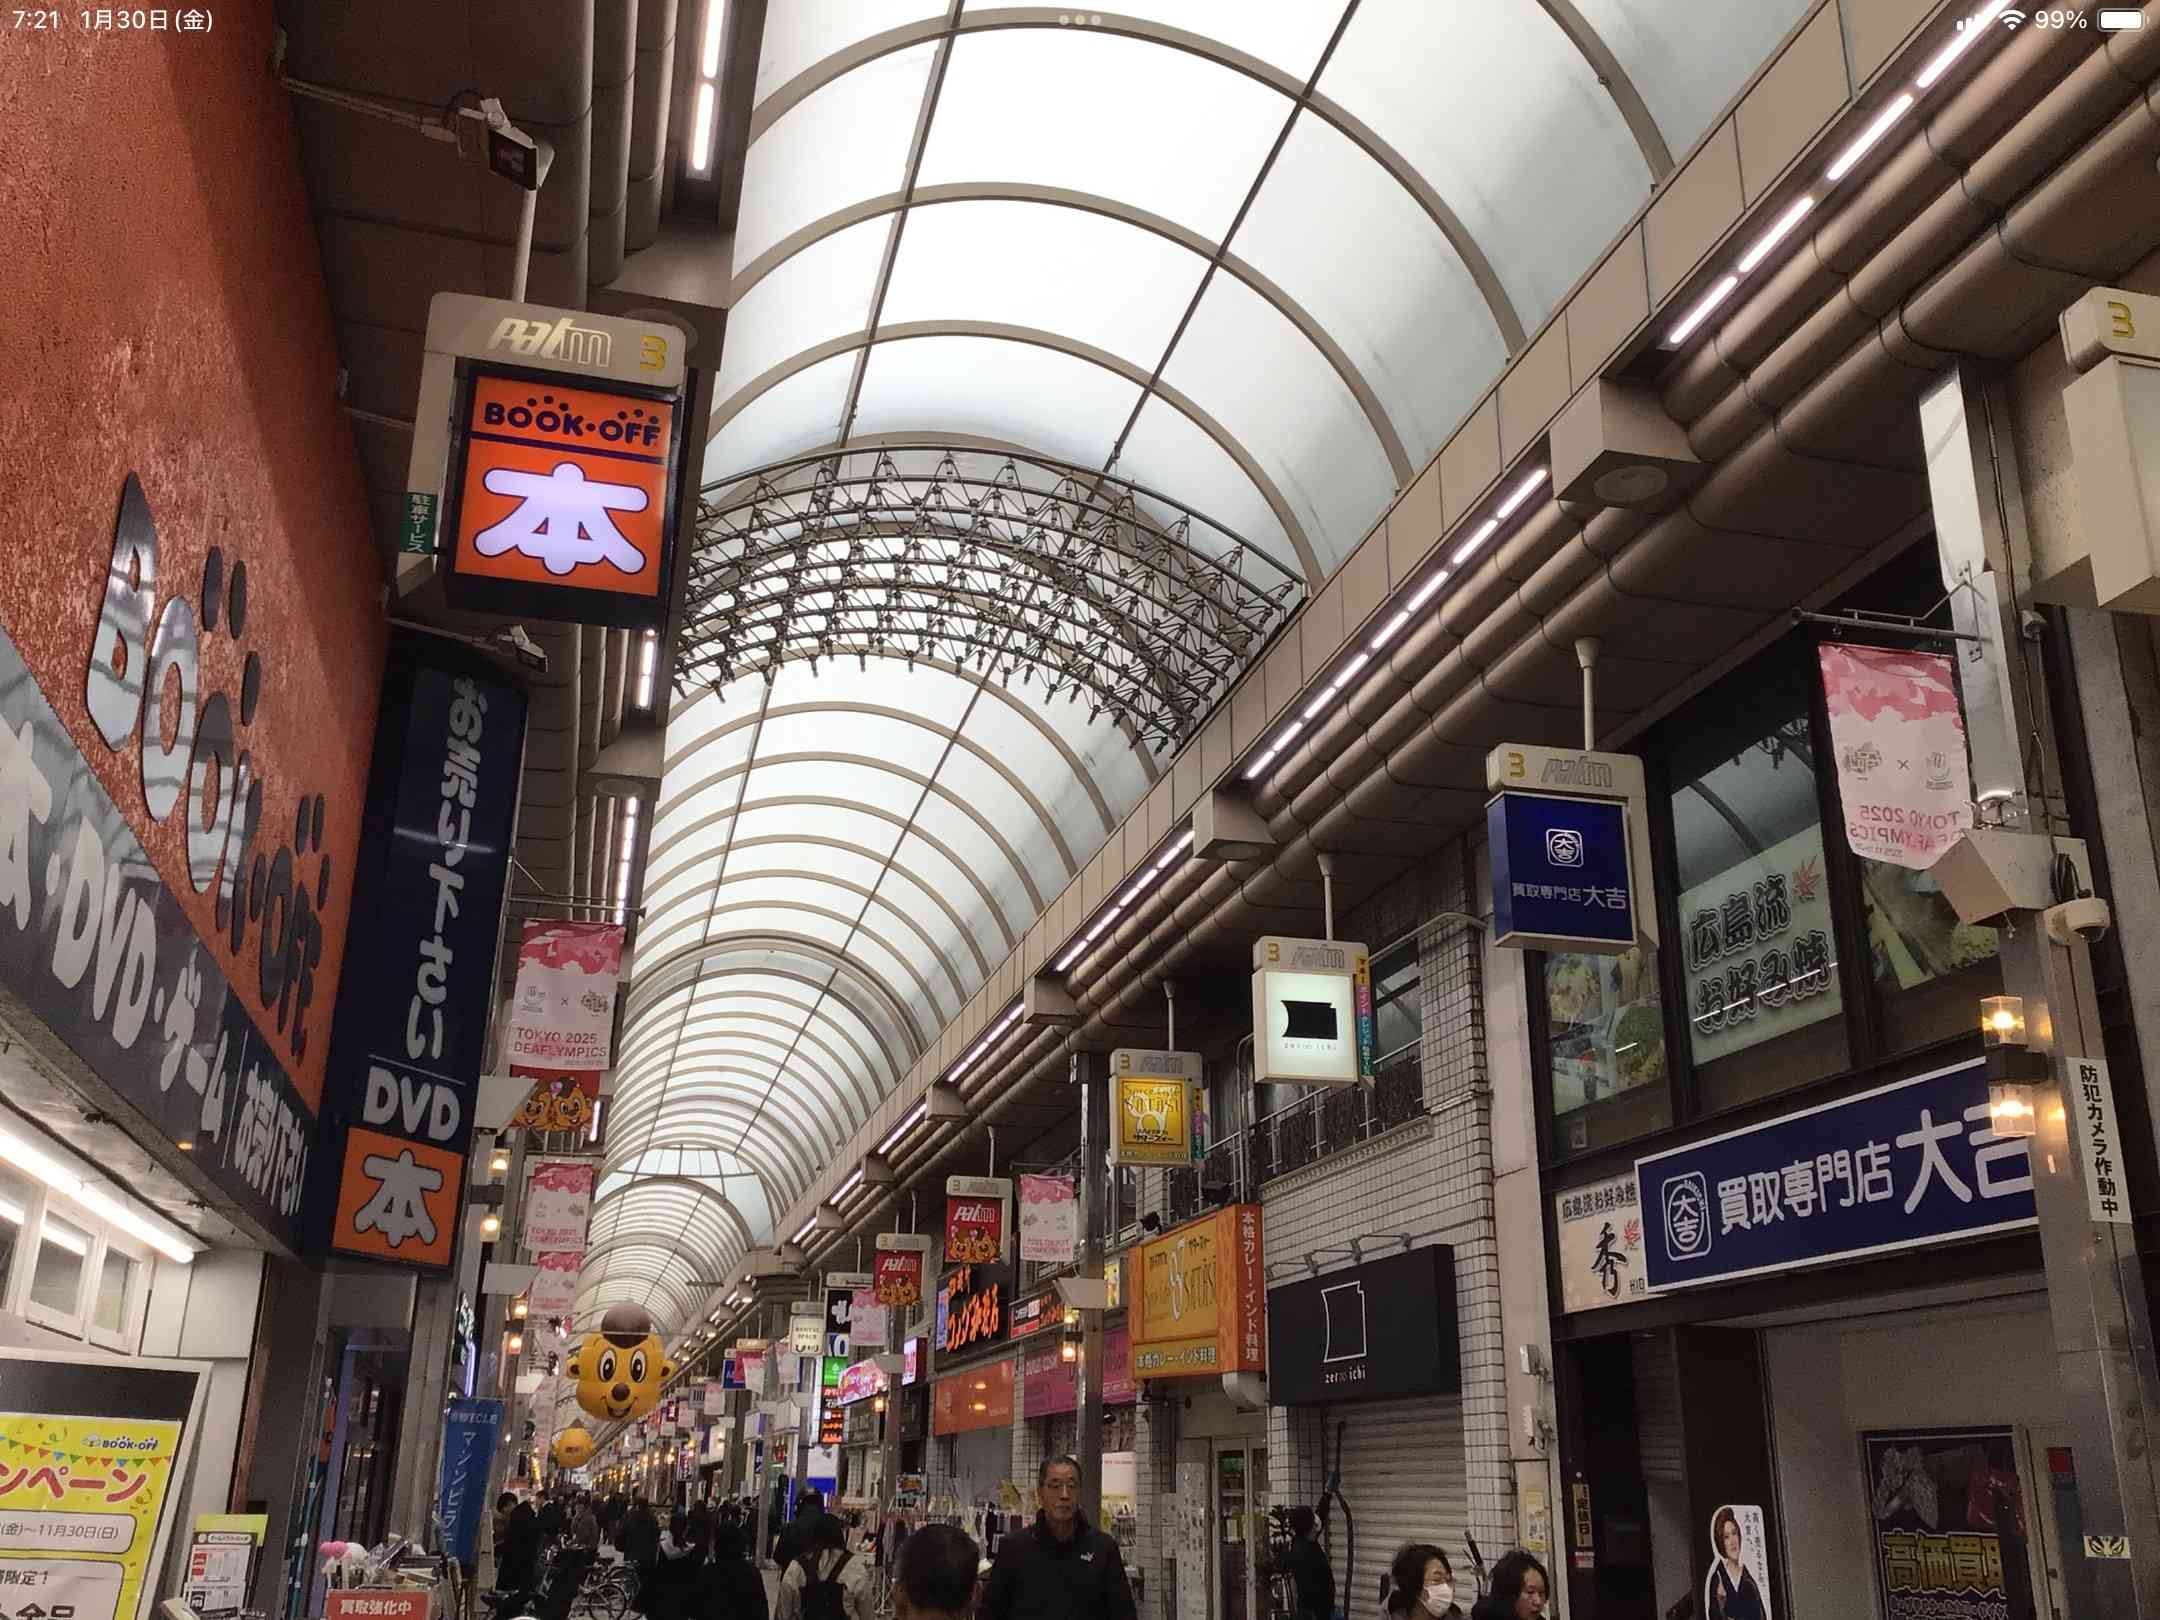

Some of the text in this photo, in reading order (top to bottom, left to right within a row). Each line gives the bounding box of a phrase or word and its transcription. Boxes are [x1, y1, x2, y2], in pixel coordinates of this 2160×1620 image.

[2107, 301, 2135, 338] 3
[639, 335, 667, 370] 3
[473, 461, 649, 576] 本
[1509, 752, 1525, 778] 3
[406, 678, 487, 1061] お売り下さい
[1512, 882, 1627, 910] 買取専門店 大吉
[1689, 873, 1791, 972] 広島流
[1268, 943, 1279, 961] 3
[514, 1041, 607, 1057] DEAFLYMPICS
[517, 1027, 598, 1044] TOKYO 2025
[1120, 1054, 1129, 1069] 3
[363, 1066, 460, 1142] DVD
[2080, 1064, 2118, 1217] 防犯カメラ作動中
[1717, 1109, 2035, 1235] 買取専門店 大吉
[353, 1149, 442, 1248] 本
[1673, 1195, 1700, 1243] 大吉
[1590, 1222, 1628, 1298] 秀
[1242, 1211, 1259, 1362] 本格カレー・インド料理
[339, 1599, 412, 1615] 買取強化中
